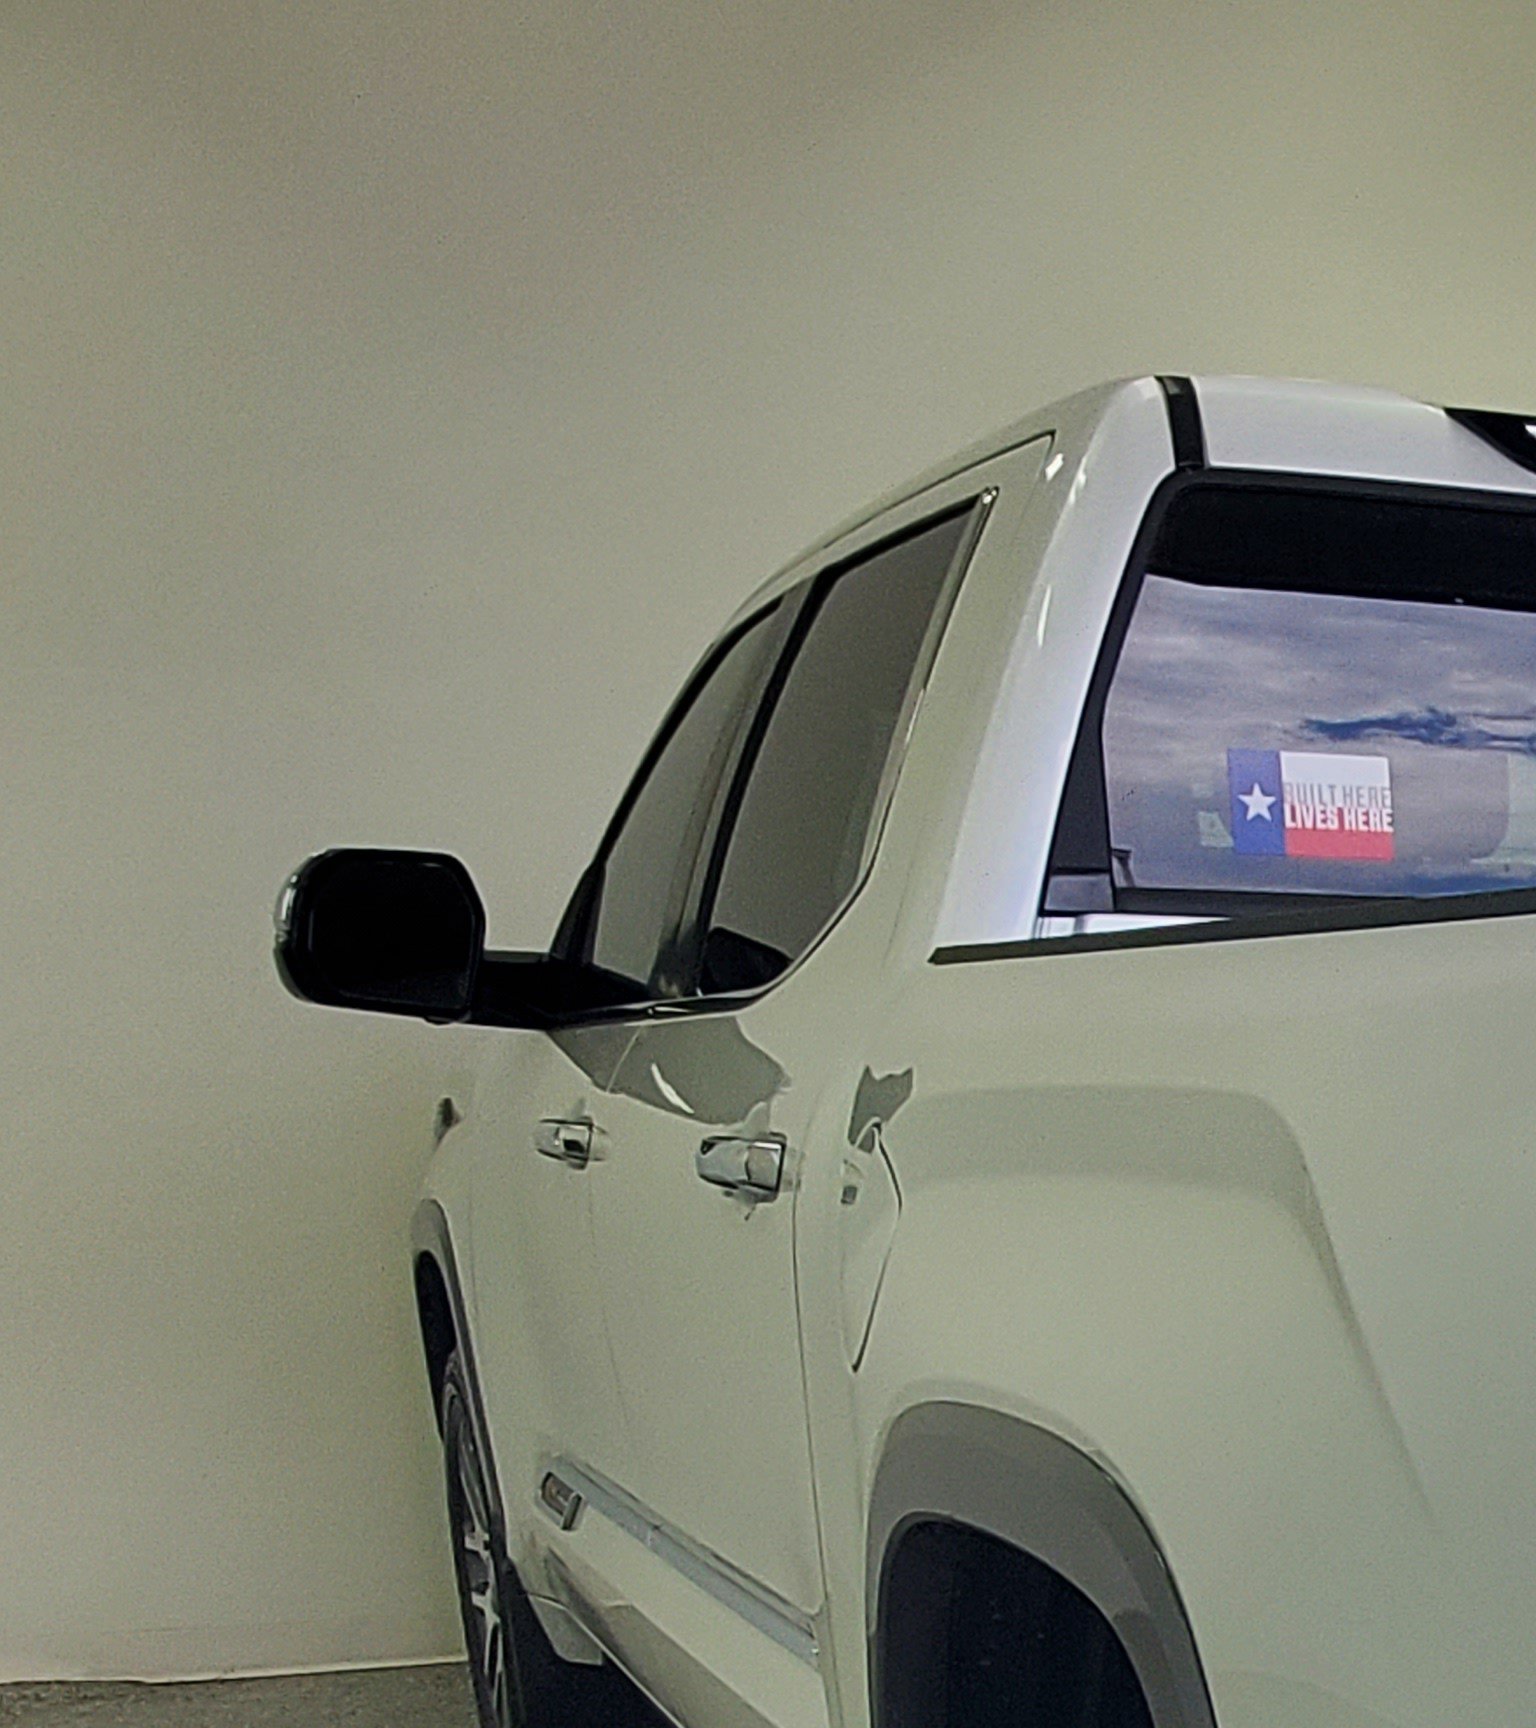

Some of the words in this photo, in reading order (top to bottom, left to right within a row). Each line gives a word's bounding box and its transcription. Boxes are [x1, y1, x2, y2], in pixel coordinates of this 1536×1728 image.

[1343, 785, 1392, 808] HERE
[1284, 803, 1338, 830] LIVES
[1344, 807, 1394, 832] HERE
